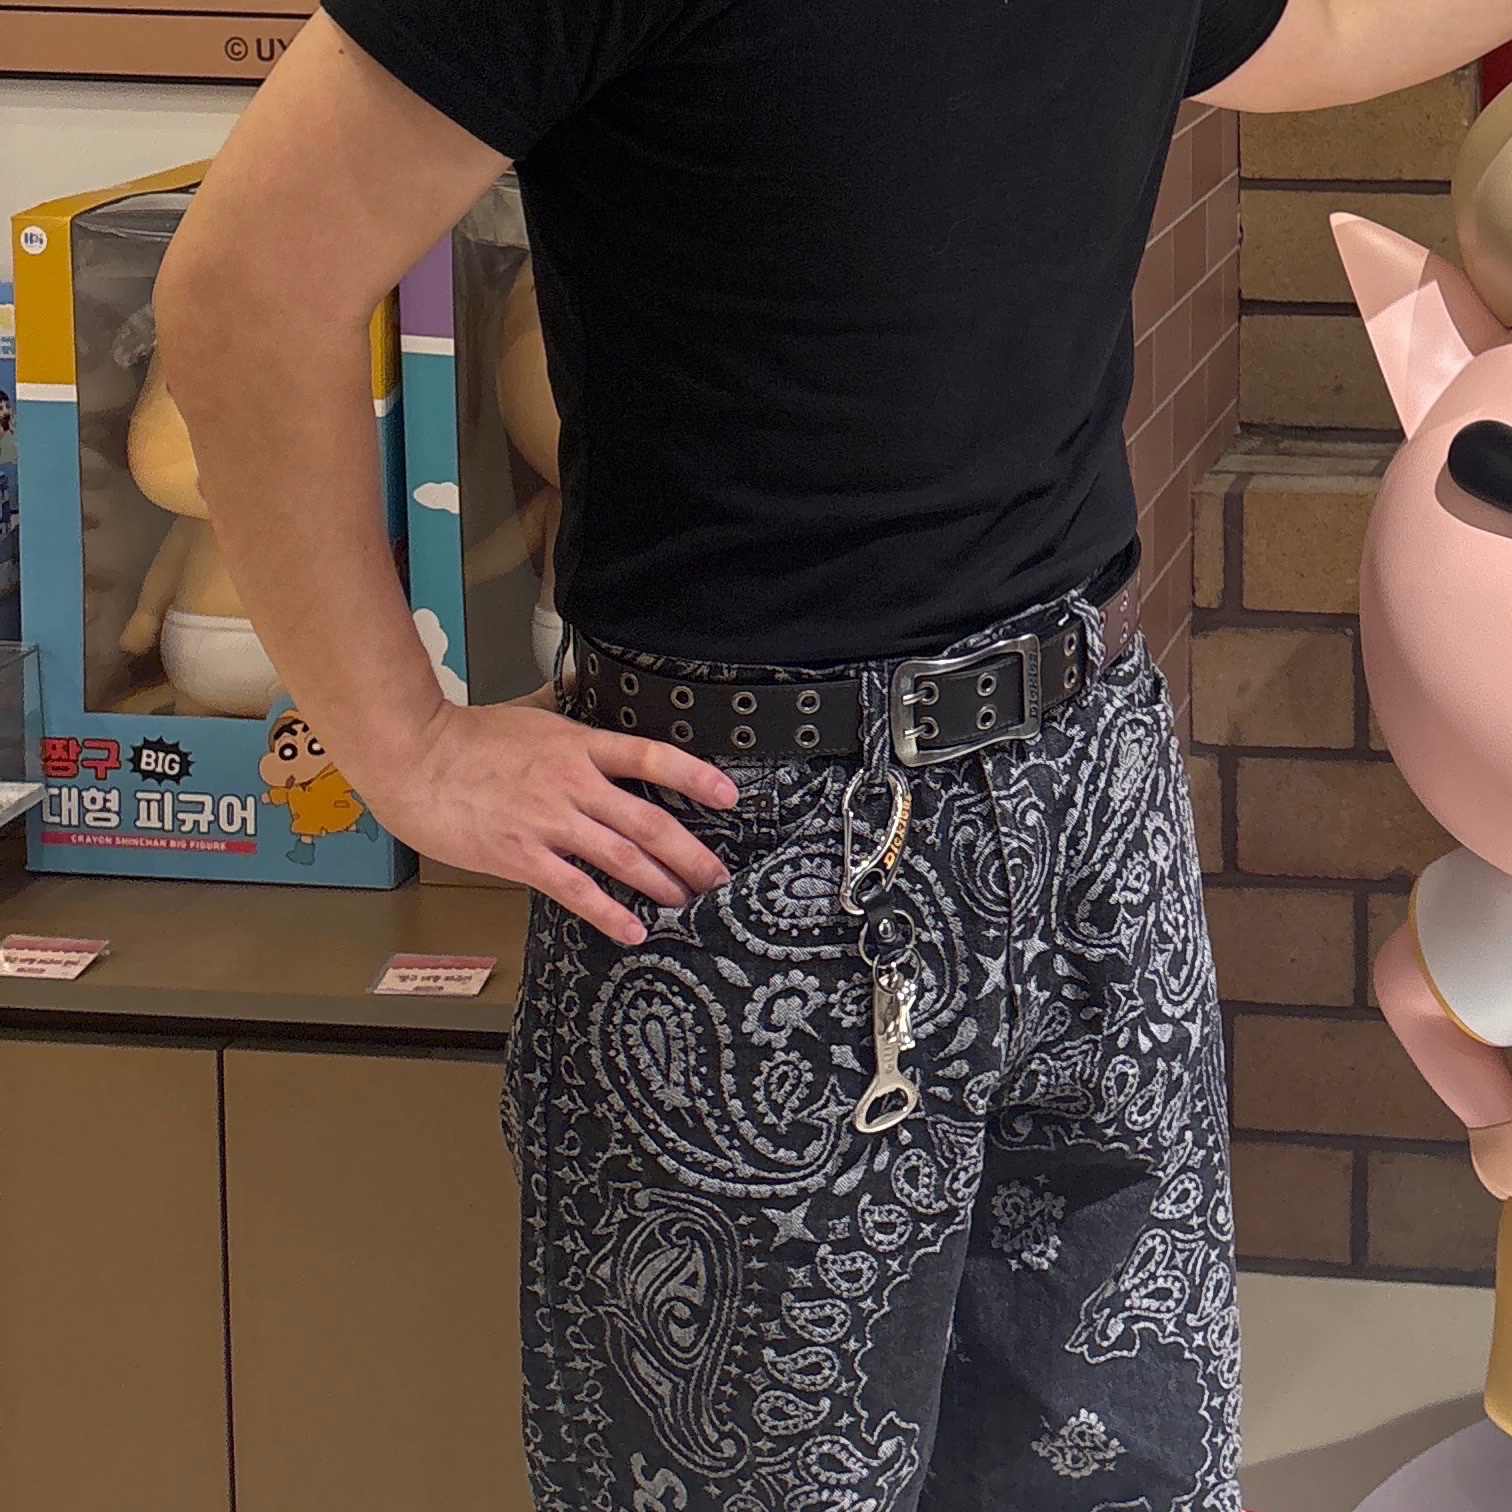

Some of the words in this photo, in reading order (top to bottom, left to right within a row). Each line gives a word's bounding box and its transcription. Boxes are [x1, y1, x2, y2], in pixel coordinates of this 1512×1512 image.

[42, 736, 122, 781] 짱구
[139, 748, 182, 777] BIG
[42, 788, 121, 829] 대형
[134, 790, 256, 837] 피규어
